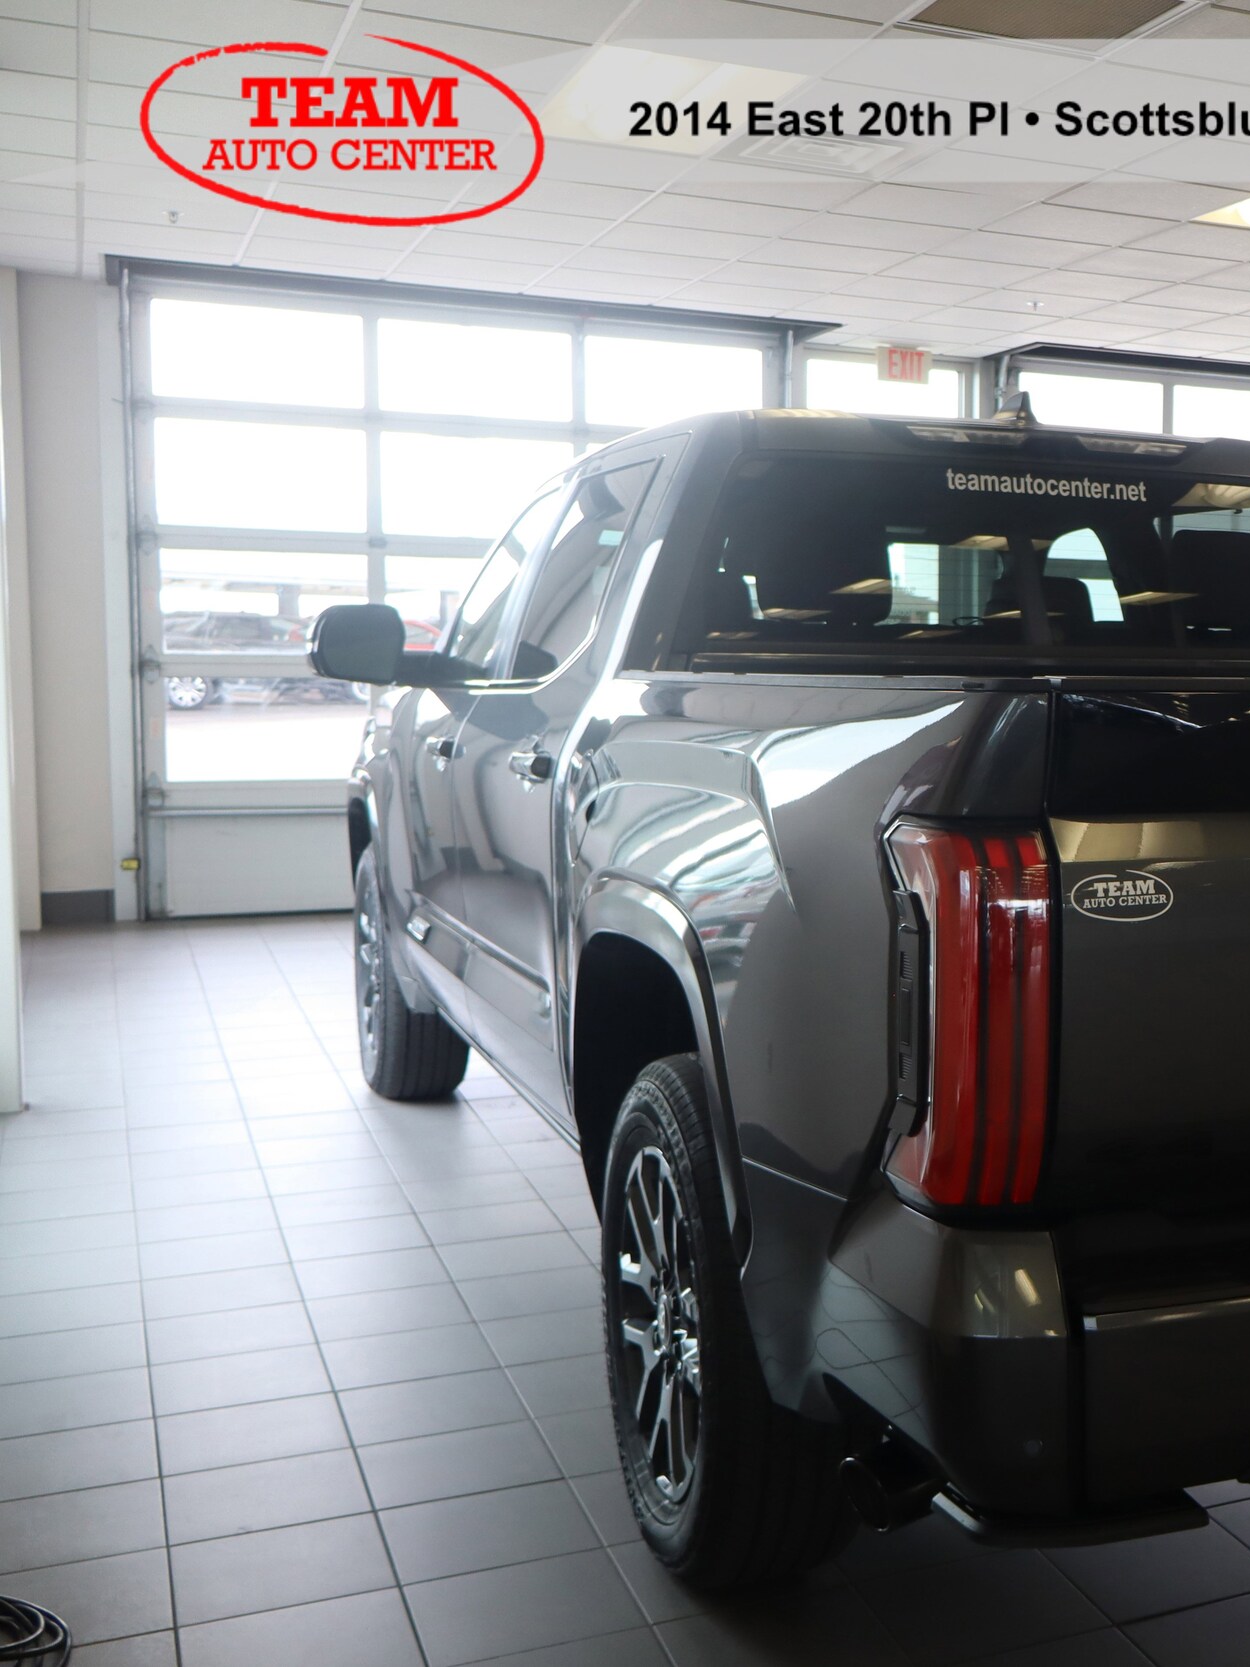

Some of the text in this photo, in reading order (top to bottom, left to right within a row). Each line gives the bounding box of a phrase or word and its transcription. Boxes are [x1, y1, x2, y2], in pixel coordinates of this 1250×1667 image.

[887, 348, 925, 383] EXIT
[946, 467, 1147, 502] teamautocenter.net
[1083, 894, 1168, 909] AUTO CENTER
[1094, 880, 1156, 897] TEAM
